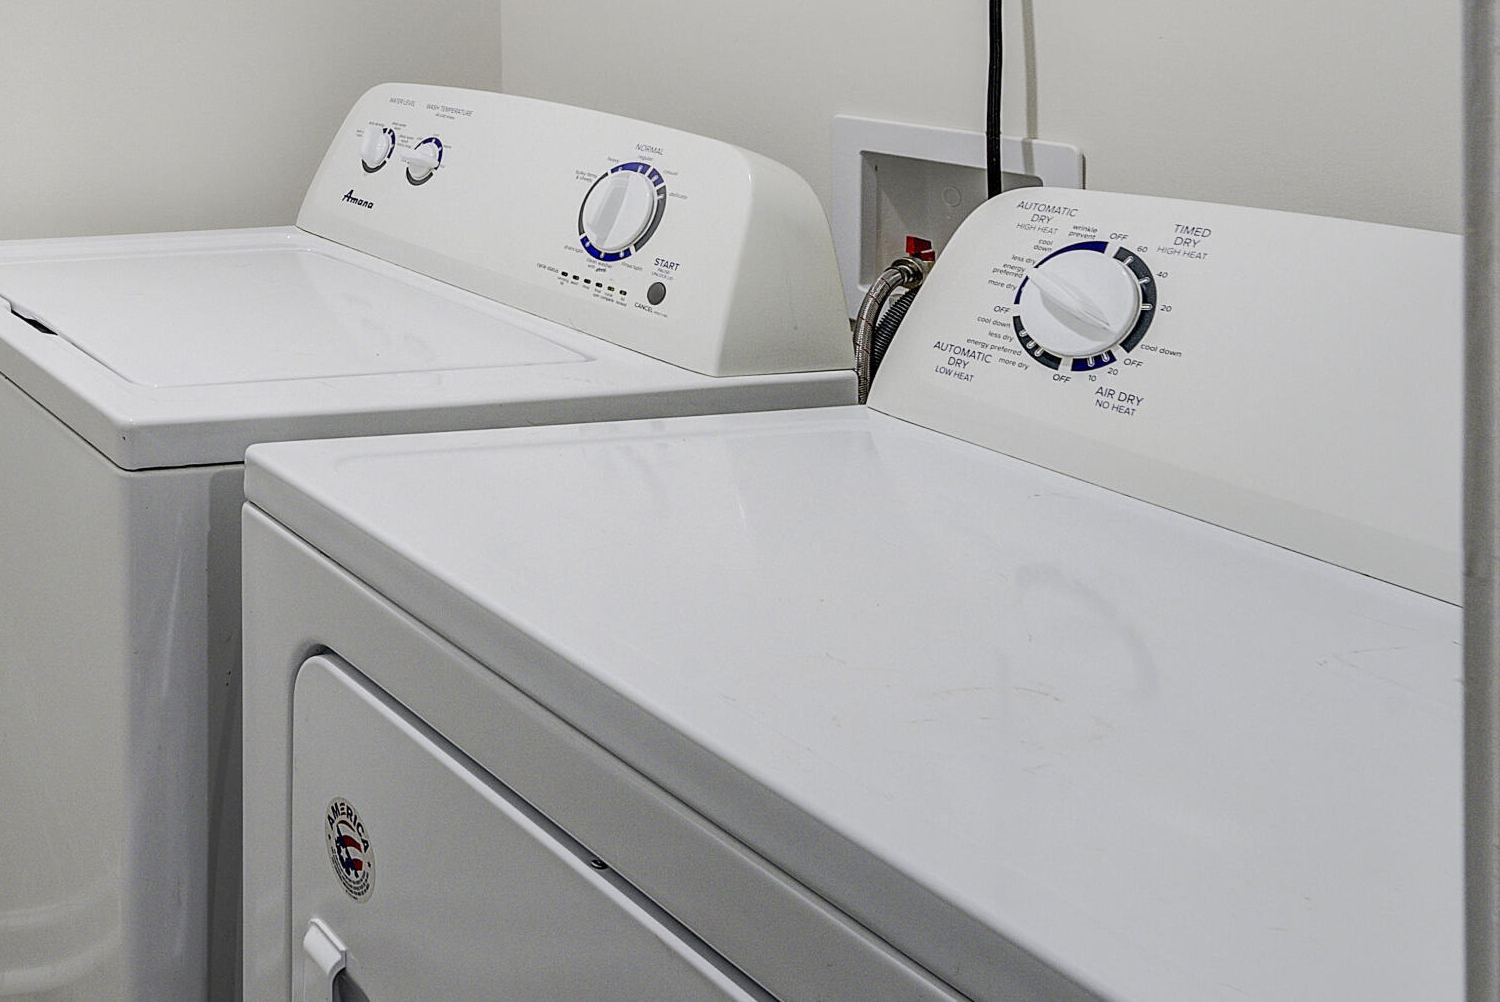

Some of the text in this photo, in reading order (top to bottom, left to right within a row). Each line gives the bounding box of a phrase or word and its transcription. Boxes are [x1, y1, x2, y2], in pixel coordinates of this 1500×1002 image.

[635, 143, 664, 156] NORMAL
[342, 189, 374, 209] Amana
[1016, 200, 1079, 218] AUTOMATIC
[1030, 213, 1054, 224] DRY
[1016, 222, 1059, 235] HIGH HEAT
[1072, 224, 1098, 234] wrinkle
[1173, 223, 1212, 238] TIMED
[1068, 230, 1096, 240] prevent
[1109, 232, 1129, 241] OFF
[1033, 244, 1052, 252] down
[1173, 236, 1201, 248] DRY
[1137, 245, 1148, 253] 60
[1156, 245, 1208, 260] HIGH HEAT
[654, 257, 680, 271] START
[1011, 254, 1036, 266] less dry
[992, 267, 1023, 279] preferred
[1002, 262, 1026, 273] energy
[1156, 271, 1168, 279] 40
[987, 279, 1017, 291] more dry
[634, 302, 653, 314] CANCEL
[993, 305, 1011, 314] OFF
[1160, 304, 1172, 312] 20
[977, 316, 1011, 328] cool down
[988, 330, 1014, 343] less dry
[933, 341, 993, 364] AUTOMATIC
[966, 338, 1022, 356] energy preferred
[1140, 343, 1182, 357] cool down
[947, 356, 970, 369] DRY
[998, 357, 1029, 371] more dry
[1123, 358, 1144, 368] OFF
[935, 365, 974, 383] LOW HEAT
[1107, 367, 1119, 376] 20
[1052, 373, 1072, 383] OFF
[1088, 374, 1097, 382] 10
[1095, 386, 1144, 407] AIR DRY
[1095, 399, 1137, 416] NO HEAT
[327, 802, 370, 853] AMERICA
